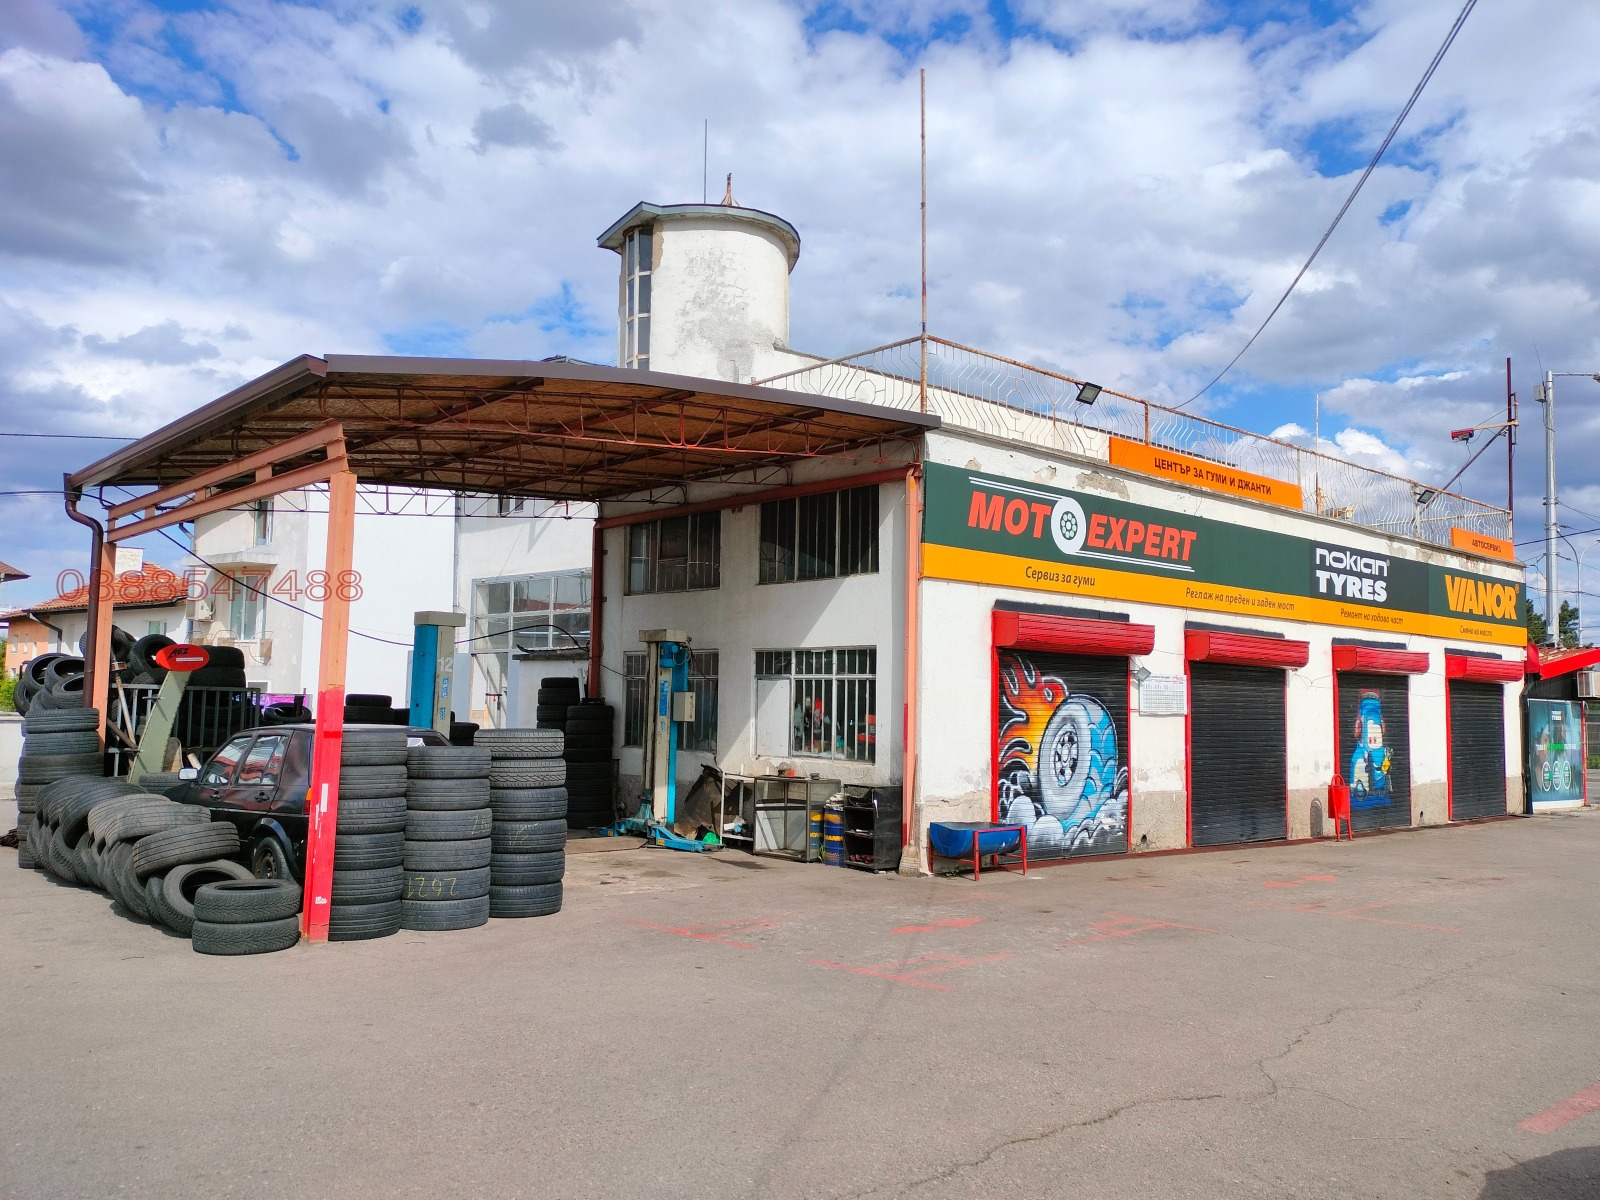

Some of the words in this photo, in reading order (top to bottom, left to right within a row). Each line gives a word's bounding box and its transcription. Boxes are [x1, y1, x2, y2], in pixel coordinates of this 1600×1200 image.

[1154, 457, 1191, 475] ЦЕНТЪР
[1193, 467, 1204, 480] ЗА
[1206, 471, 1227, 485] ГУМИ
[1229, 476, 1236, 487] И
[1237, 478, 1272, 495] ДЖАНТИ
[1087, 513, 1197, 562] EXPERT
[1025, 566, 1059, 584] Сервиз
[1061, 572, 1072, 583] за
[1073, 575, 1096, 587] гуми
[1316, 570, 1388, 602] TYRES
[1185, 587, 1213, 600] Реглаж
[1214, 594, 1224, 602] на
[1225, 594, 1250, 605] преден
[1256, 597, 1276, 608] заден
[1277, 602, 1295, 611] мост
[1444, 574, 1517, 620] VIANOR
[1340, 608, 1363, 620] Ремонт
